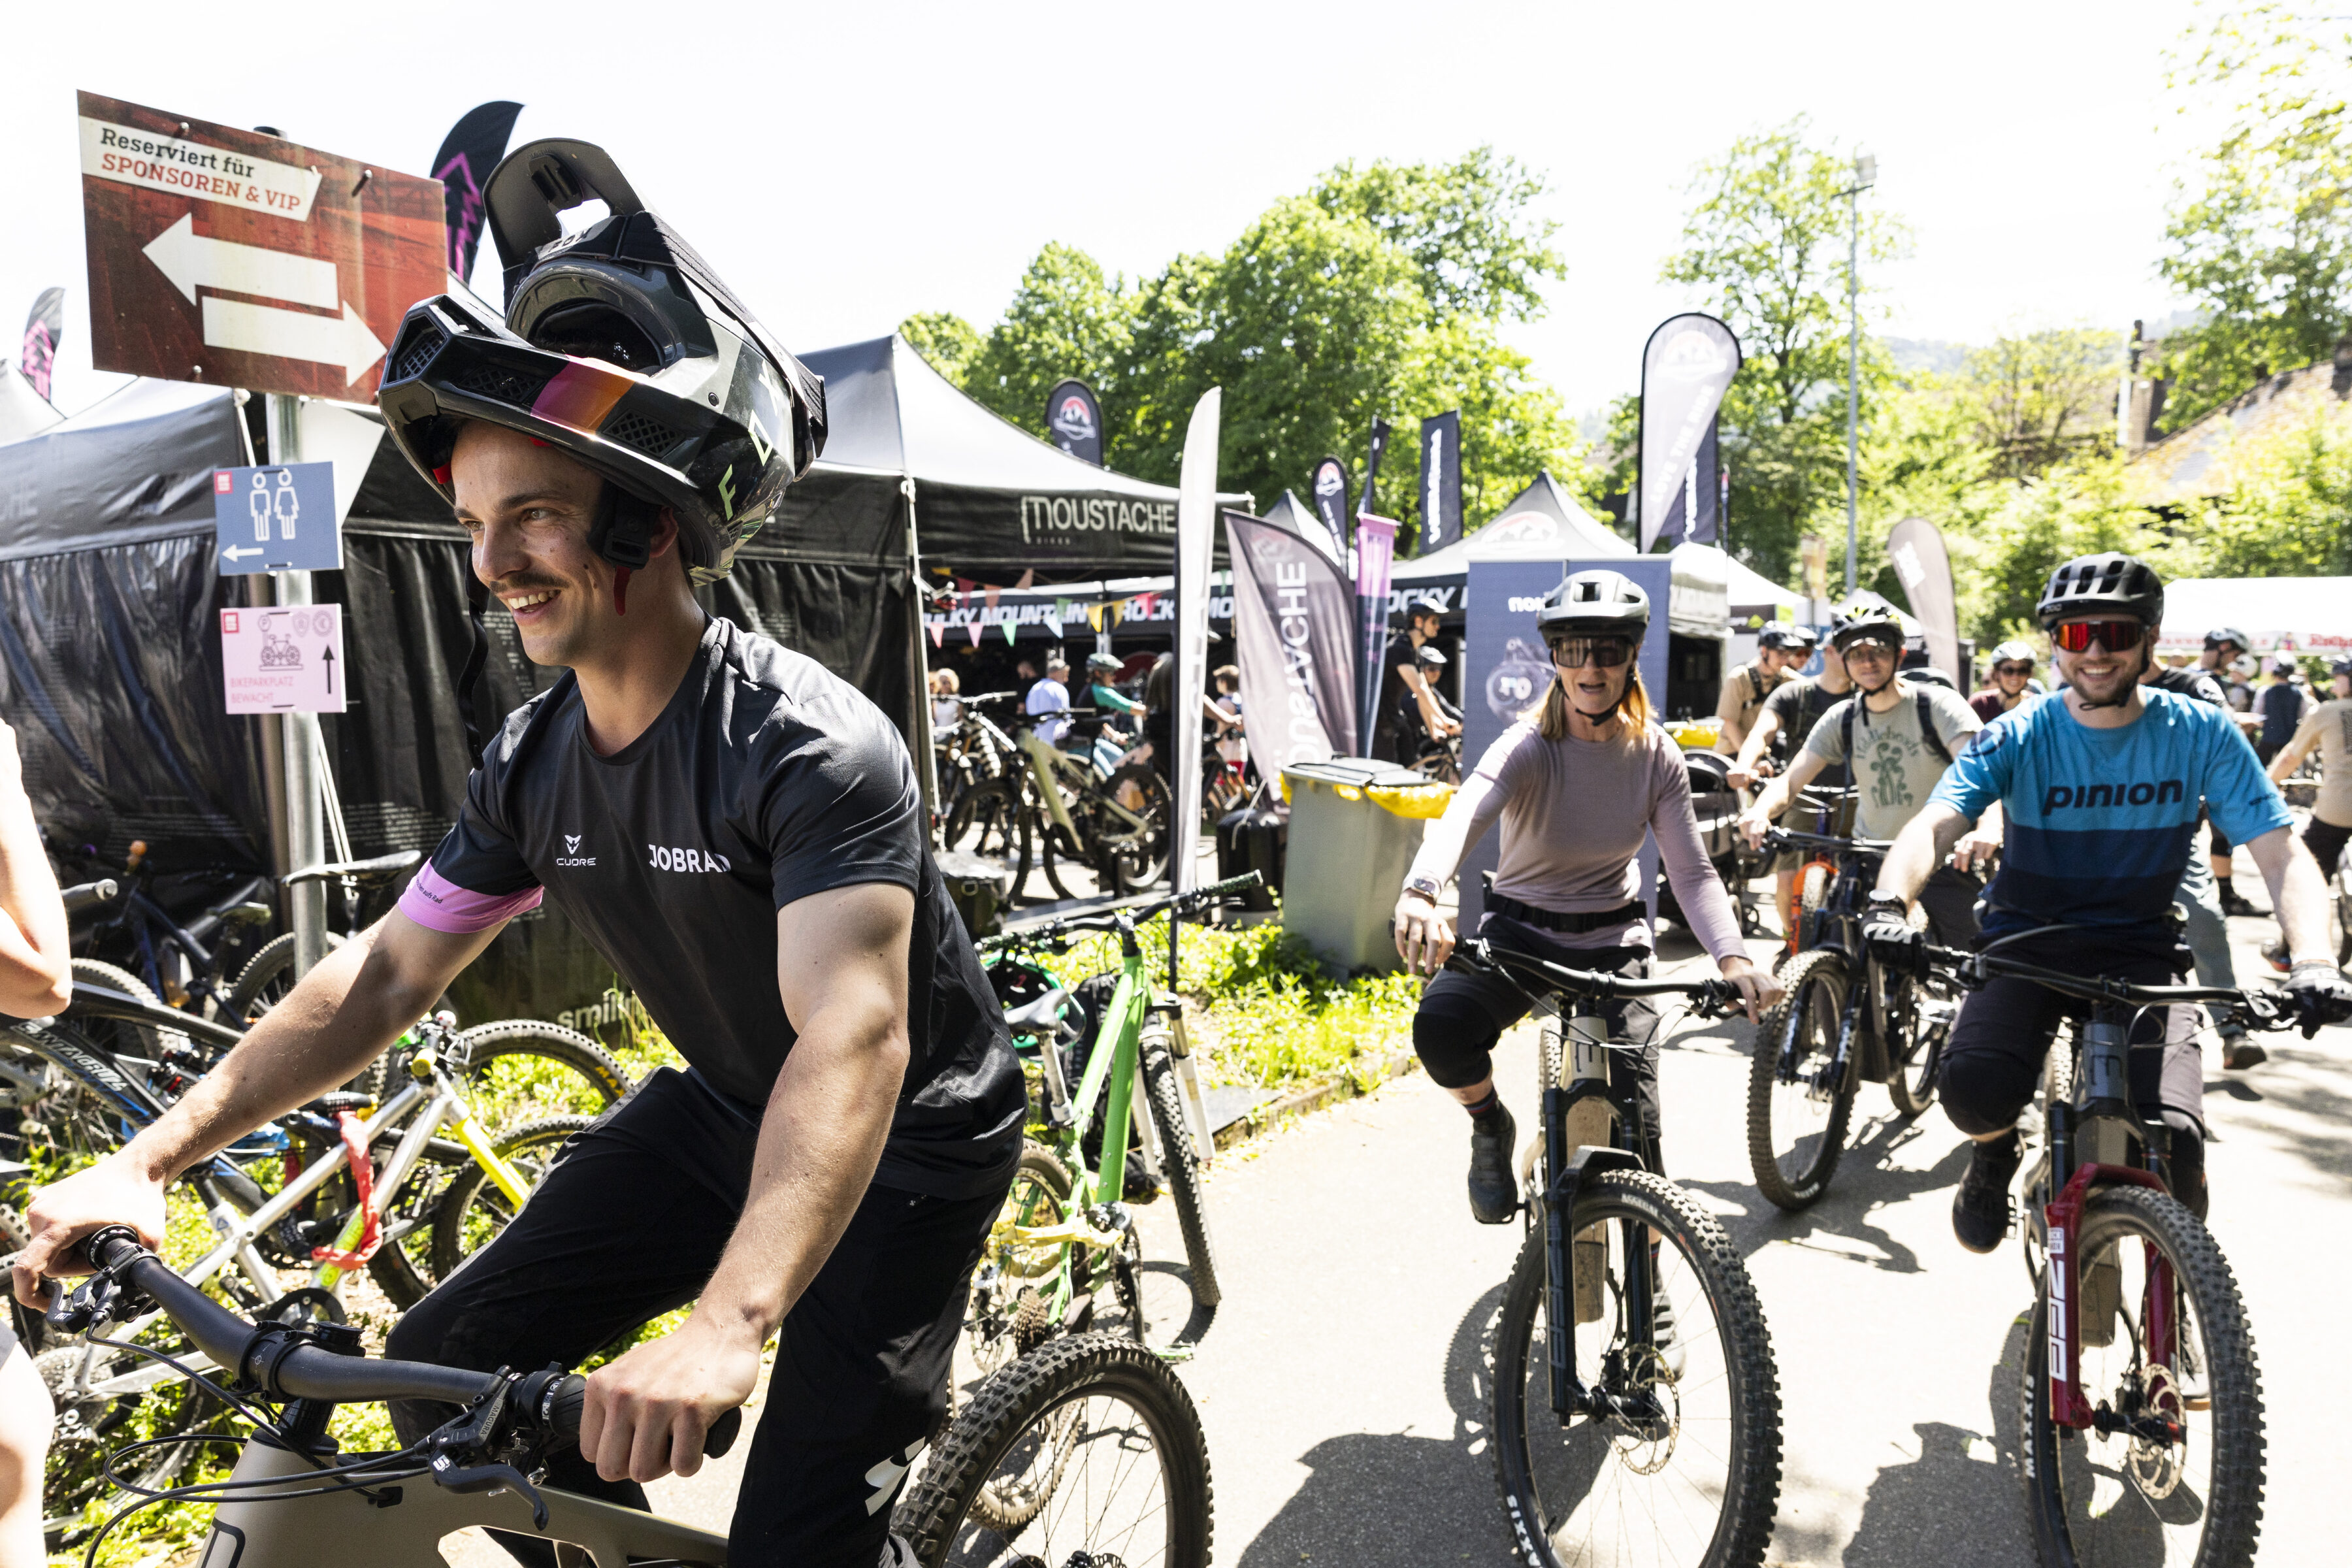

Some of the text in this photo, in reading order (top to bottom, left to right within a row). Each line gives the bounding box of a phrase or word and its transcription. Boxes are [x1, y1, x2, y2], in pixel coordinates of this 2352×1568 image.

[101, 128, 255, 178] Reserviert für
[101, 152, 301, 210] SPONSOREN & VIP
[717, 358, 779, 521] FOX
[1021, 495, 1177, 543] MOUSTACHE
[1386, 585, 1456, 613] OCKY
[231, 676, 293, 688] BIKEPARKPLATZ
[231, 692, 274, 704] BEWACHT
[2042, 779, 2183, 816] pinion
[556, 857, 596, 866] CUORE
[423, 890, 433, 899] aufs
[432, 895, 444, 904] Rad
[480, 1405, 500, 1435] MAGURA
[2023, 1374, 2036, 1479] MAXXIS
[1506, 1494, 1543, 1568] AXXIS
